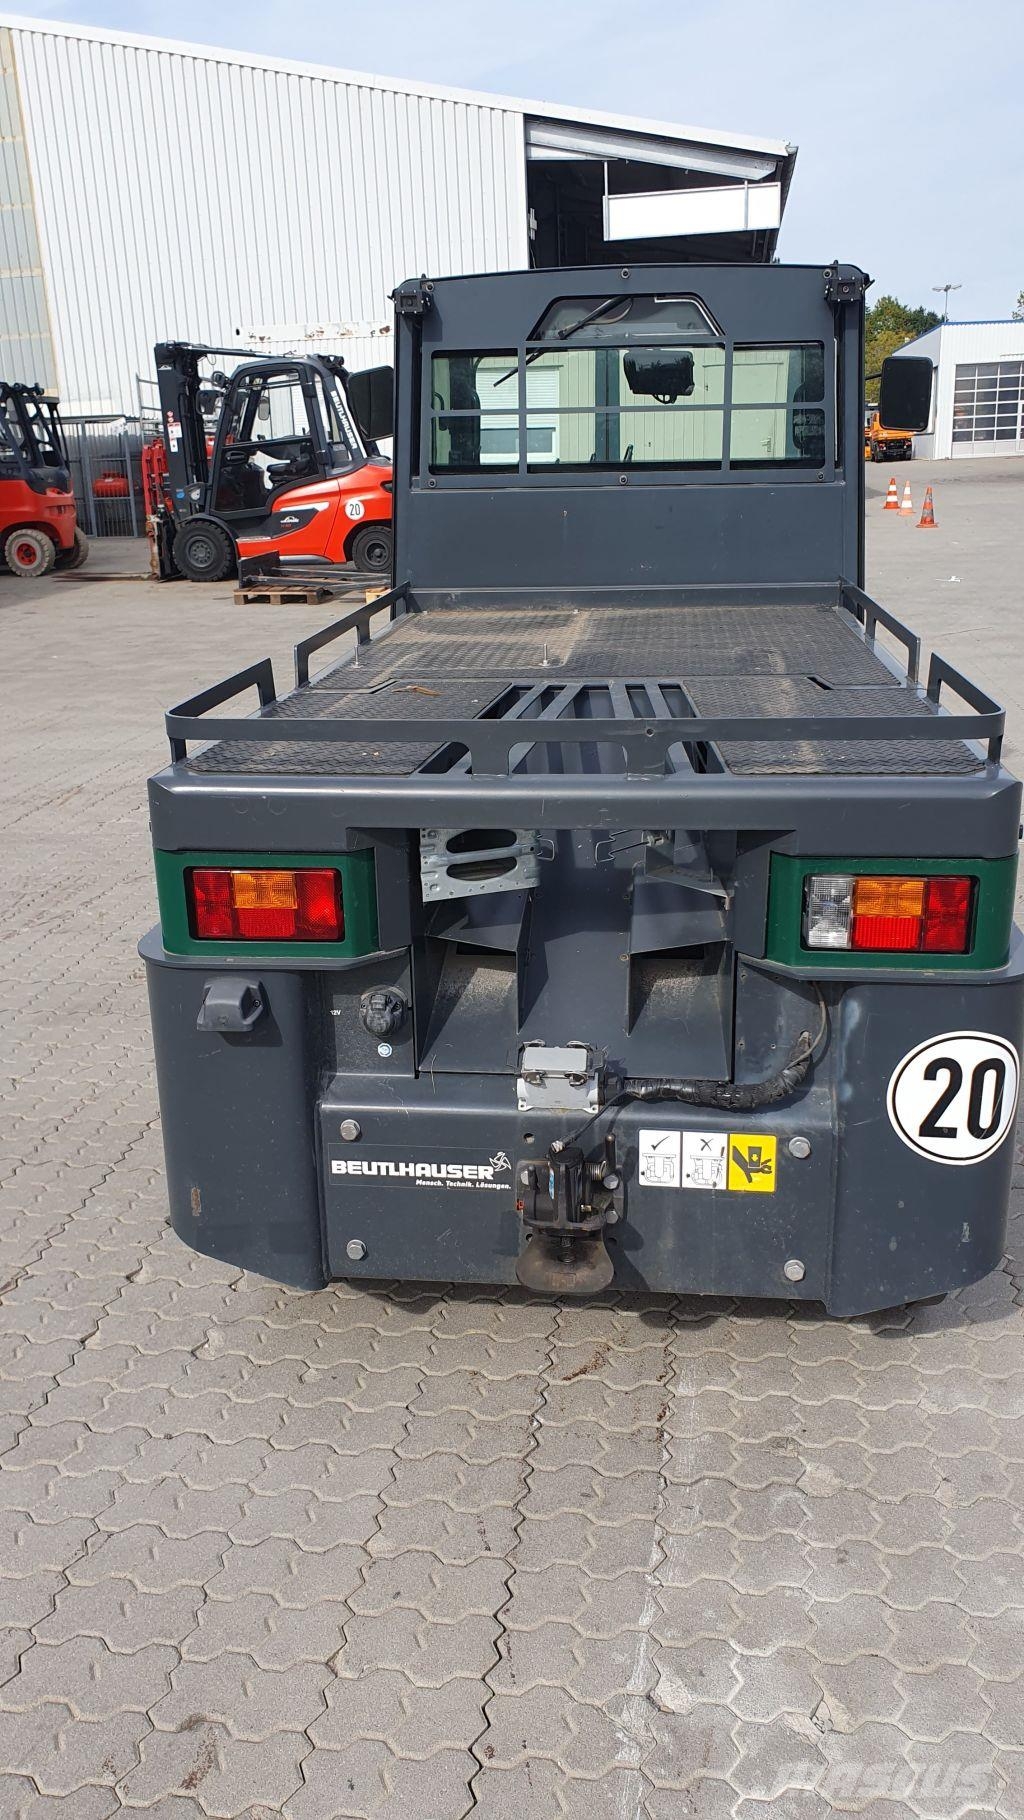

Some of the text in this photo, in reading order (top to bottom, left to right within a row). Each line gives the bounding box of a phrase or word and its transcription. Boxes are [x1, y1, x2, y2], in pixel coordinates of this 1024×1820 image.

[330, 390, 358, 449] BEUTLHAUSER
[349, 503, 361, 516] 20
[918, 1056, 1006, 1140] 20
[331, 1159, 494, 1180] BEUTLHAUSER
[415, 1178, 512, 1191] Mensch. Technik. Lösungen.
